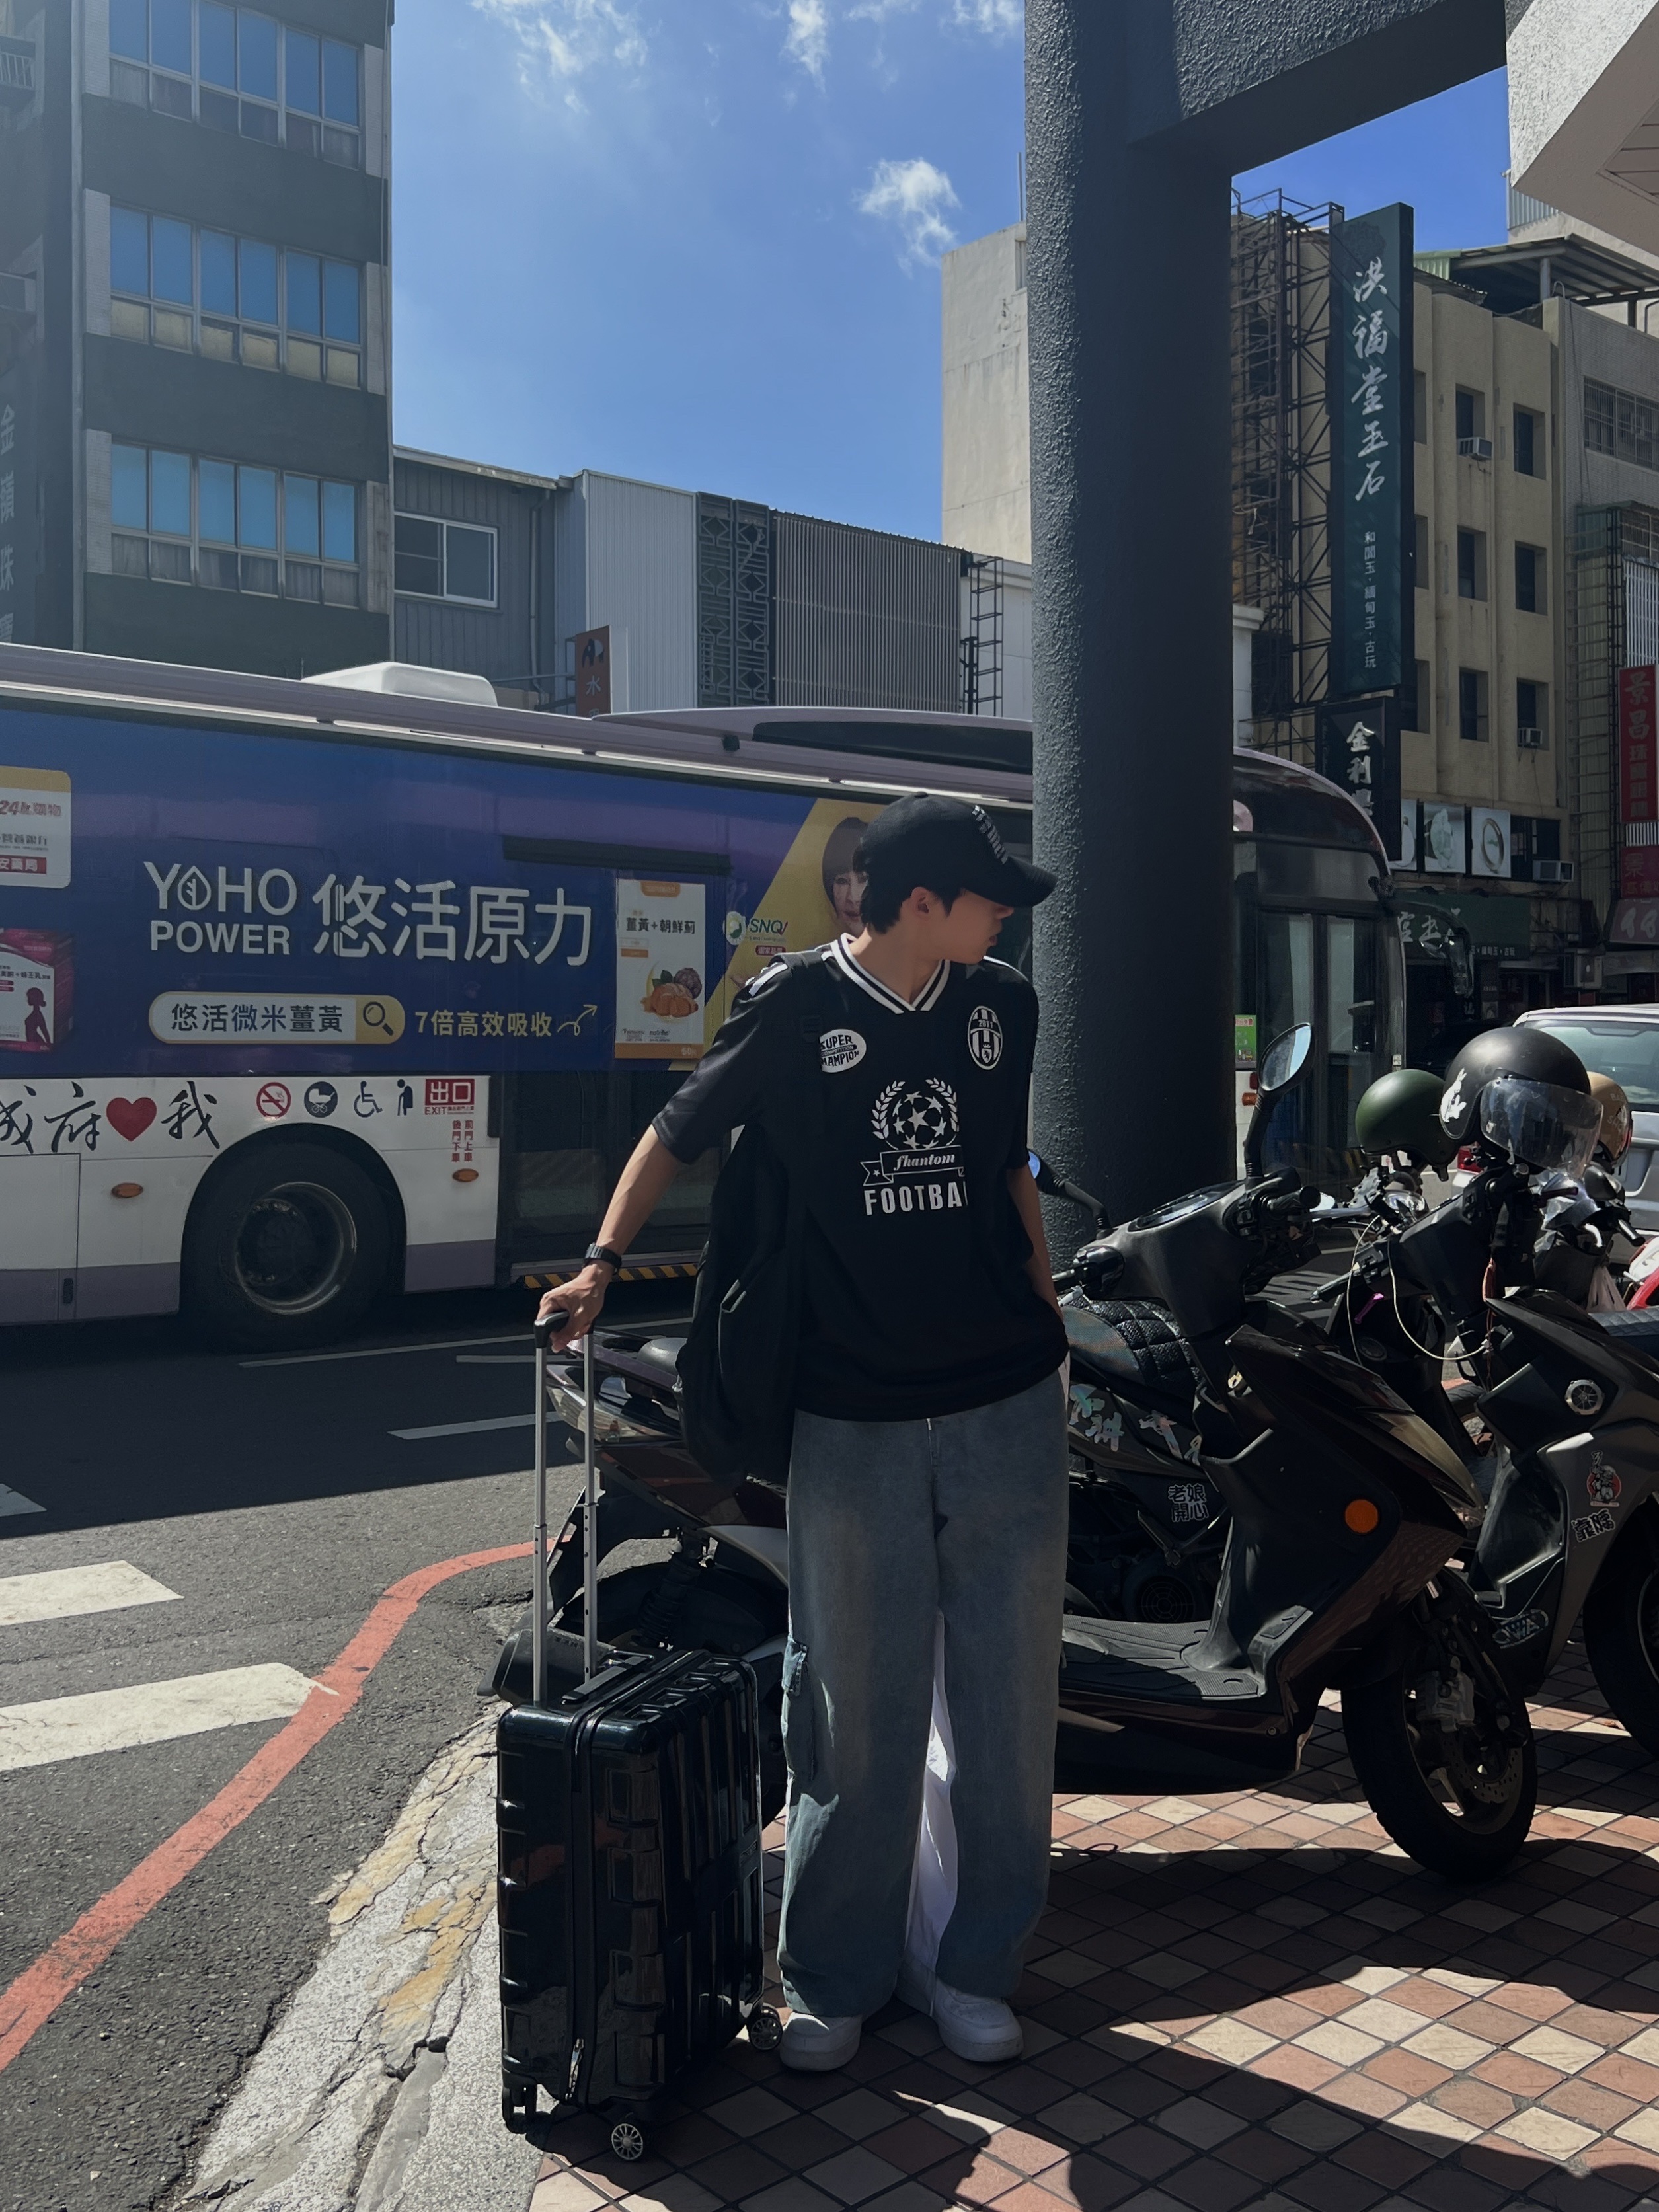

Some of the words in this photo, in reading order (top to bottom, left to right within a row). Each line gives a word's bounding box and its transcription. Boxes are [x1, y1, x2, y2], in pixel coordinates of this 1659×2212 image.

[1351, 256, 1388, 501] 洪福堂玉石
[313, 874, 591, 966] 悠活原力
[151, 920, 291, 955] POWER
[171, 1003, 342, 1032] 悠活微米薑黃
[414, 1009, 553, 1038] 7倍高效吸收
[820, 1034, 853, 1050] SUPER
[430, 1081, 471, 1104] 出口
[424, 1106, 447, 1116] EXIT
